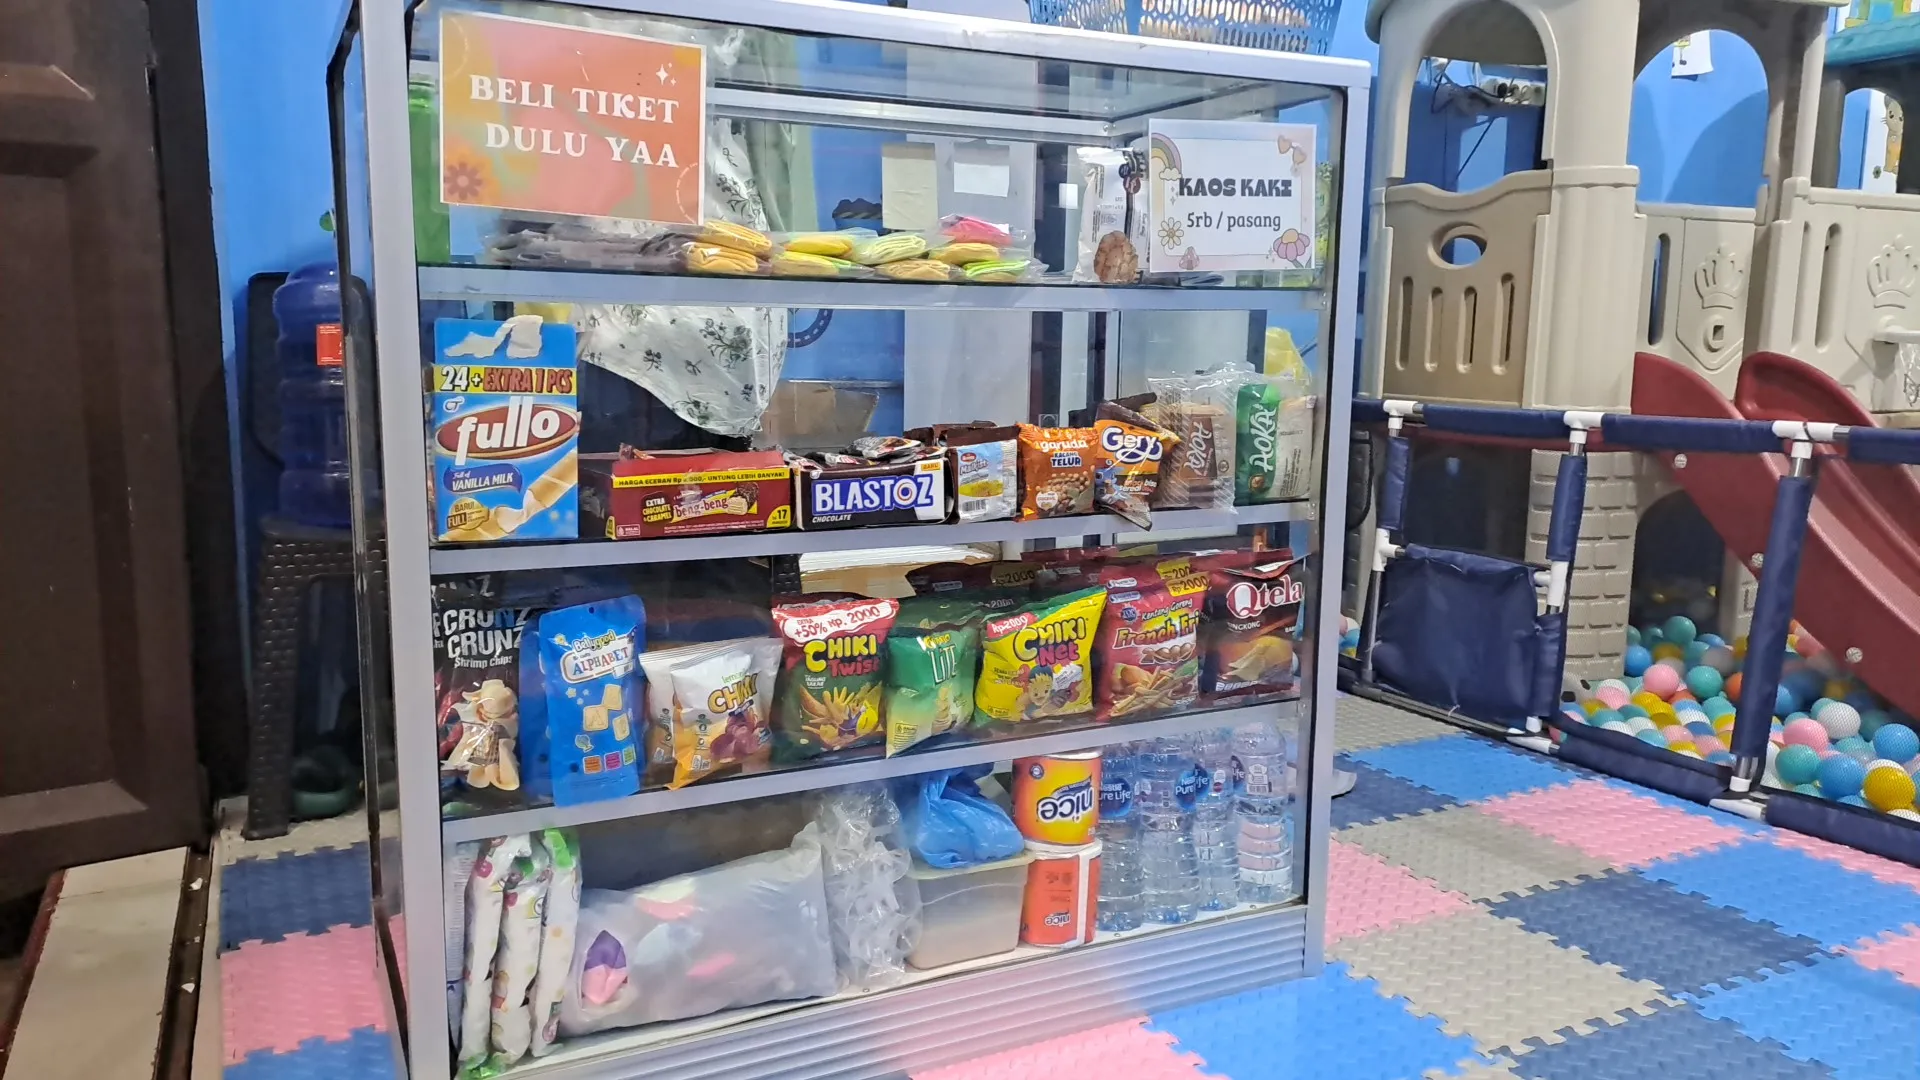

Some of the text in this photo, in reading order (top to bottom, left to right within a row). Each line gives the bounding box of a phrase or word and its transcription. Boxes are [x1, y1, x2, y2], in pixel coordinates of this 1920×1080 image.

[470, 74, 679, 124] BELI TIKET
[485, 122, 679, 168] DULU YAA
[1179, 178, 1292, 197] KAOS KAKI
[1187, 211, 1212, 229] 5rb
[1227, 214, 1281, 231] pasang
[483, 367, 534, 392] EXTRA
[546, 368, 573, 393] PCS
[455, 396, 560, 465] fullo
[1249, 405, 1277, 473] AOKA
[1040, 439, 1088, 452] garuda
[1102, 427, 1163, 462] Gery
[1183, 421, 1212, 470] AOKA
[1051, 457, 1081, 466] TELUR
[452, 473, 513, 491] VANILLA MILK
[645, 477, 672, 485] ECERAN
[708, 473, 736, 481] UNTUNG
[737, 472, 756, 480] LEBIH
[814, 476, 933, 512] BLASTOZ
[642, 504, 671, 515] CHOCOLATE
[647, 512, 672, 522] CARAMEL
[675, 497, 728, 518] beng-beng
[777, 509, 787, 519] 17
[812, 514, 851, 523] CHOCOLATE
[1181, 576, 1208, 590] 2000
[1226, 574, 1304, 619] Qtela
[443, 607, 531, 635] CRUNZ
[1142, 606, 1170, 621] Kentang
[1170, 598, 1193, 612] Goreng
[795, 622, 828, 637] +50%
[847, 606, 880, 623] 2000
[1113, 610, 1200, 649] French Fri
[448, 626, 521, 658] CRUNZ
[1013, 617, 1086, 662] CHIKI
[454, 656, 513, 669] Shrimp Chips
[573, 647, 628, 675] ALPHABET
[803, 634, 877, 672] CHIKI
[1038, 641, 1080, 667] Net
[829, 657, 880, 677] Twist
[1196, 777, 1209, 788] ife
[1233, 770, 1245, 780] ife
[1040, 788, 1093, 821] nice
[1116, 790, 1131, 803] Life
[1045, 914, 1070, 926] nice
